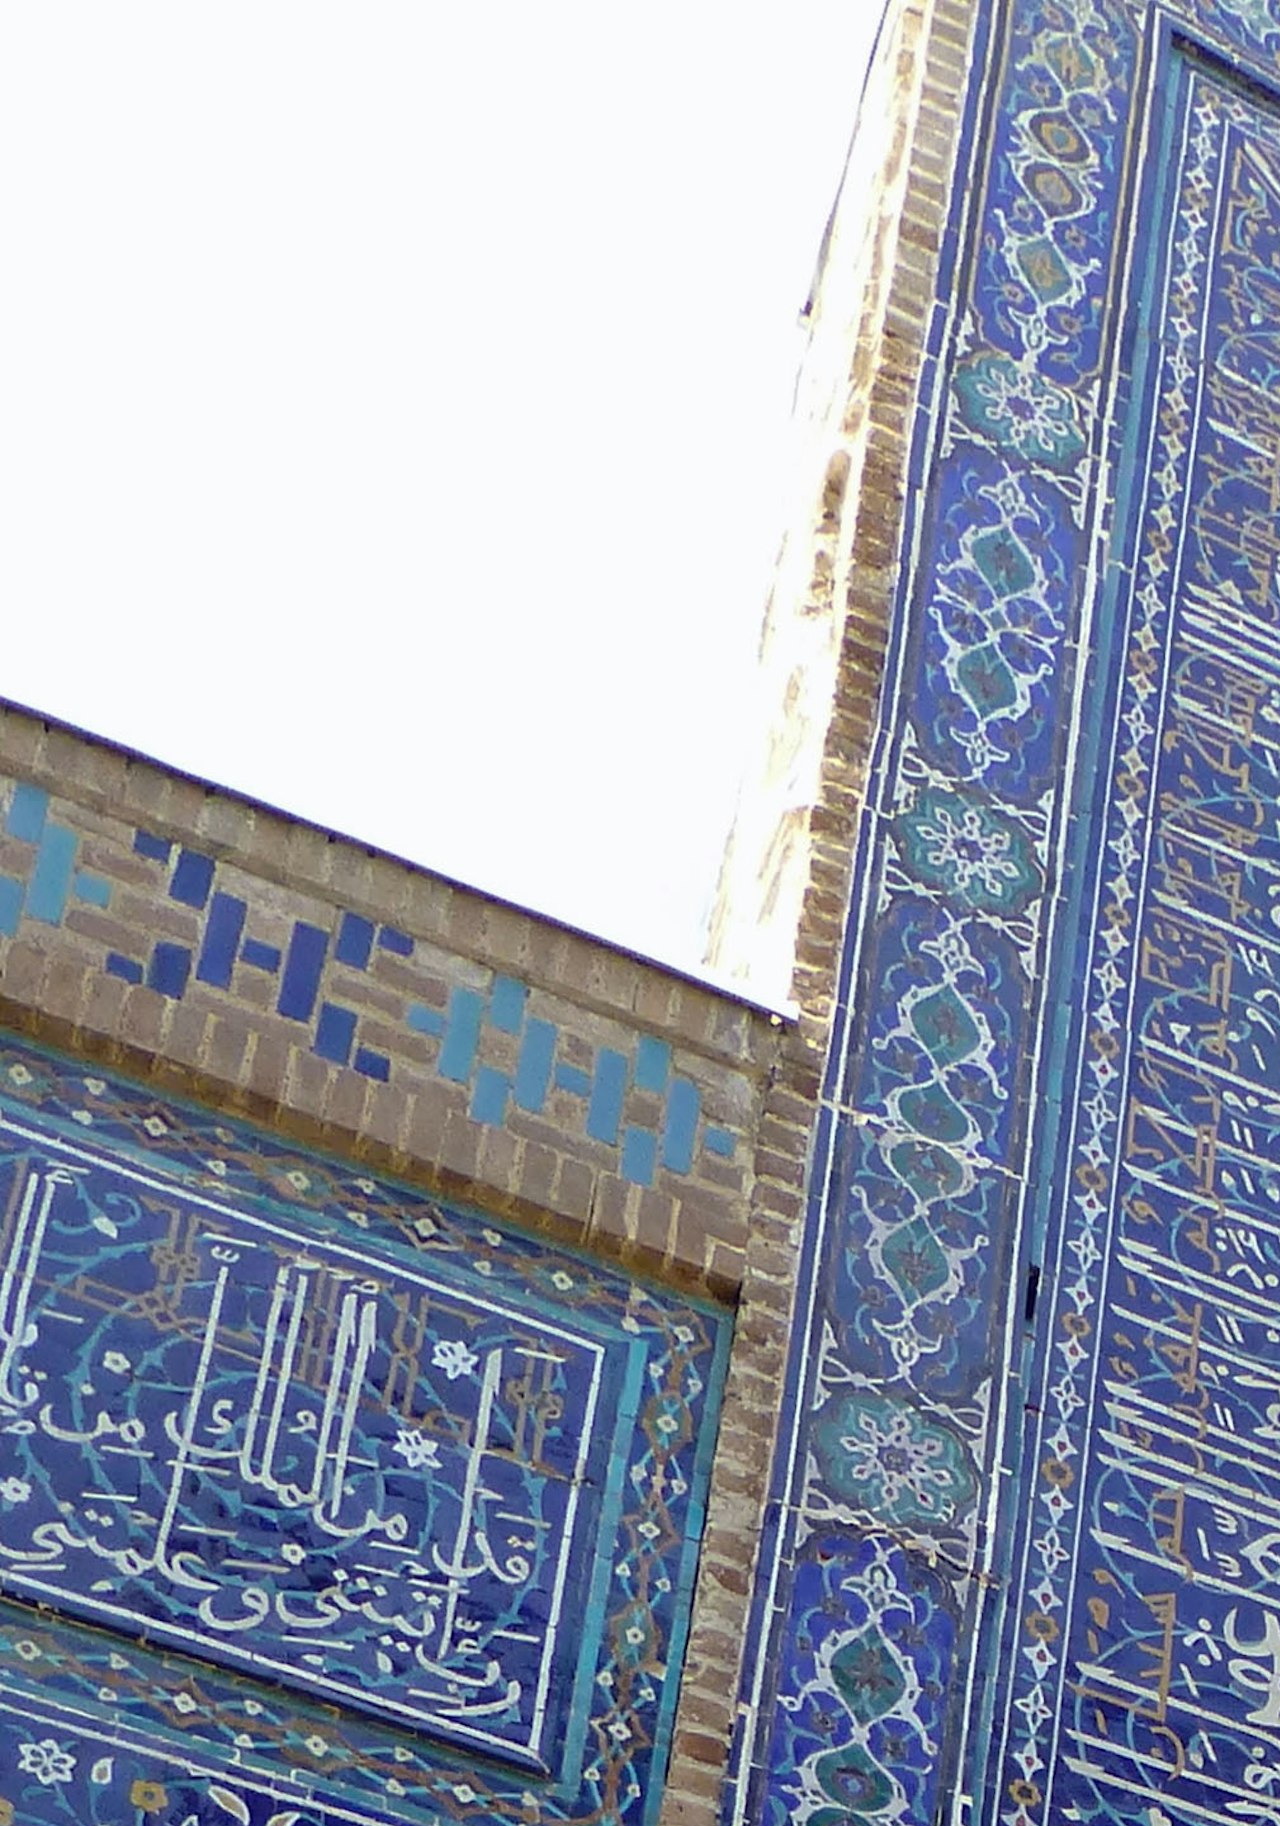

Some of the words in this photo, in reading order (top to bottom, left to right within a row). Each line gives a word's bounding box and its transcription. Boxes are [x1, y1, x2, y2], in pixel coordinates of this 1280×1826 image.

[40, 1395, 147, 1445] من
[164, 1265, 378, 1520] الملك
[313, 1487, 409, 1542] من
